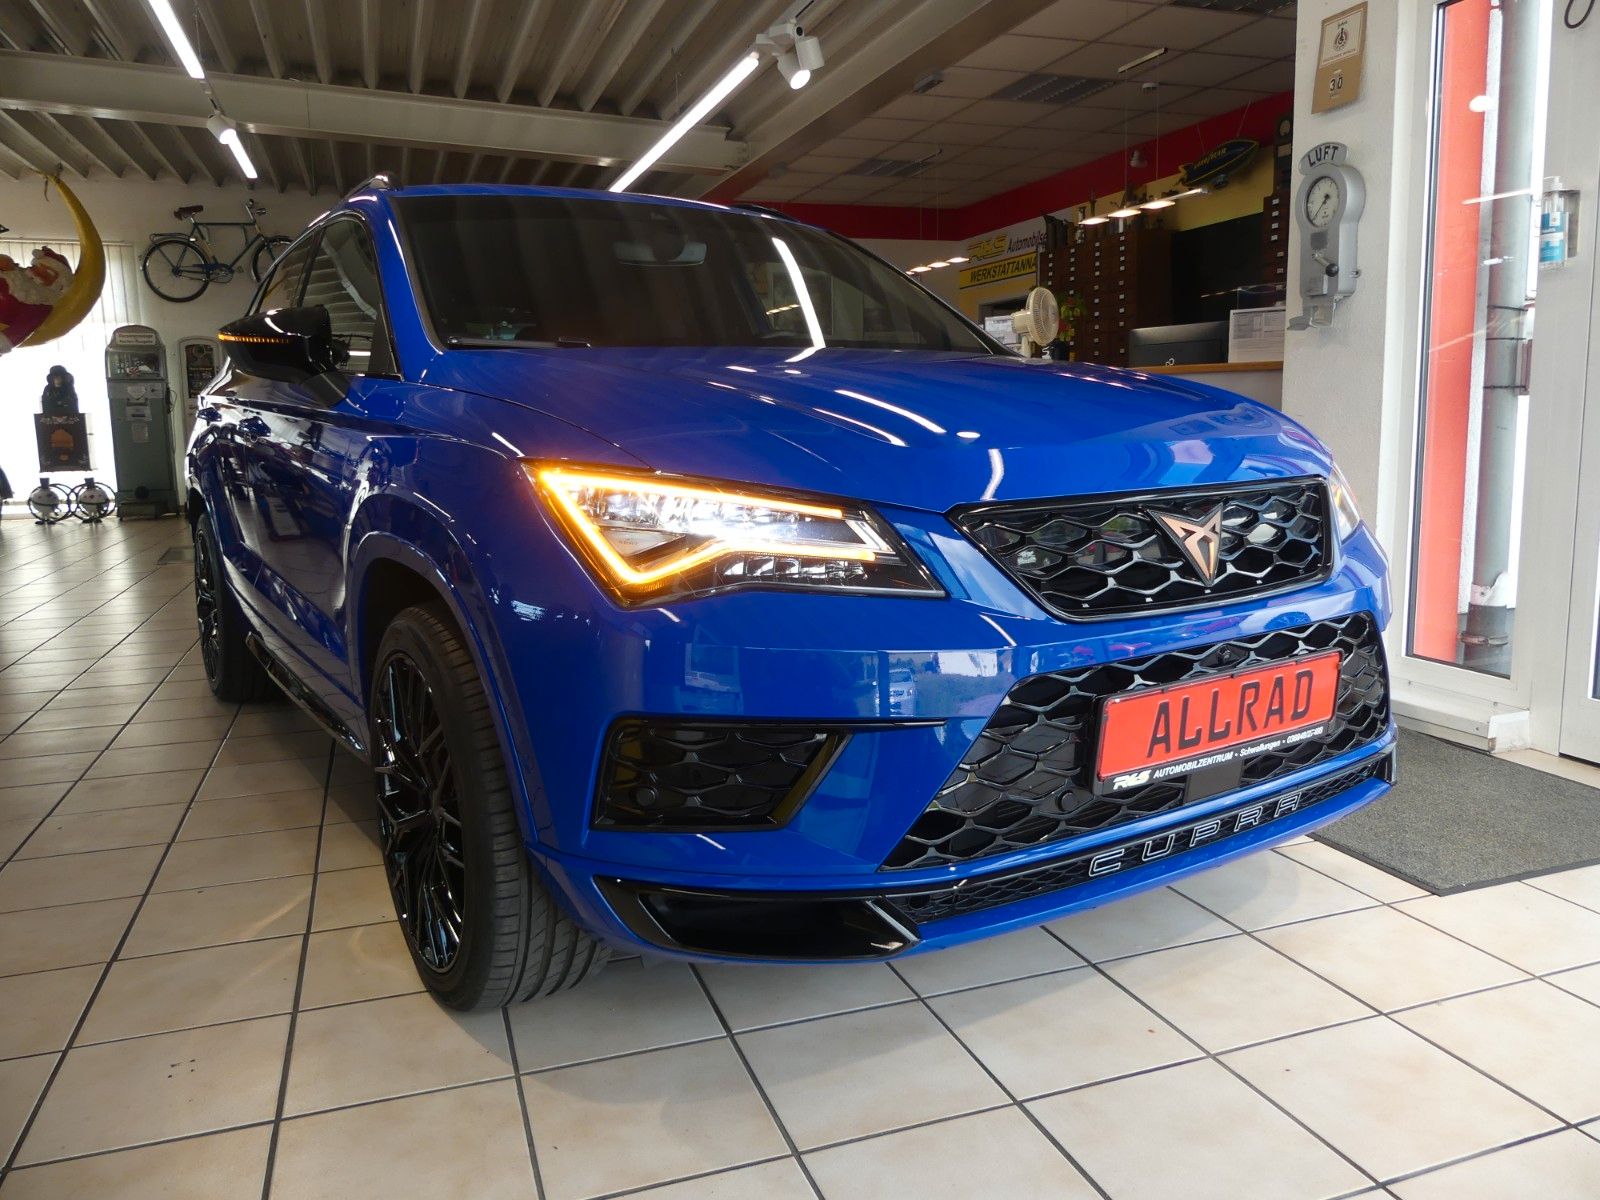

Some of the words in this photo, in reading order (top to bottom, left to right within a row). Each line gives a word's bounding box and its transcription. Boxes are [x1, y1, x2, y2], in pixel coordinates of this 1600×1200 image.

[1307, 145, 1339, 167] LUFT
[1146, 669, 1314, 758] ALLRAD
[1153, 752, 1234, 779] AUTOMOBILZENTRUM
[1088, 792, 1302, 877] CUPRA
